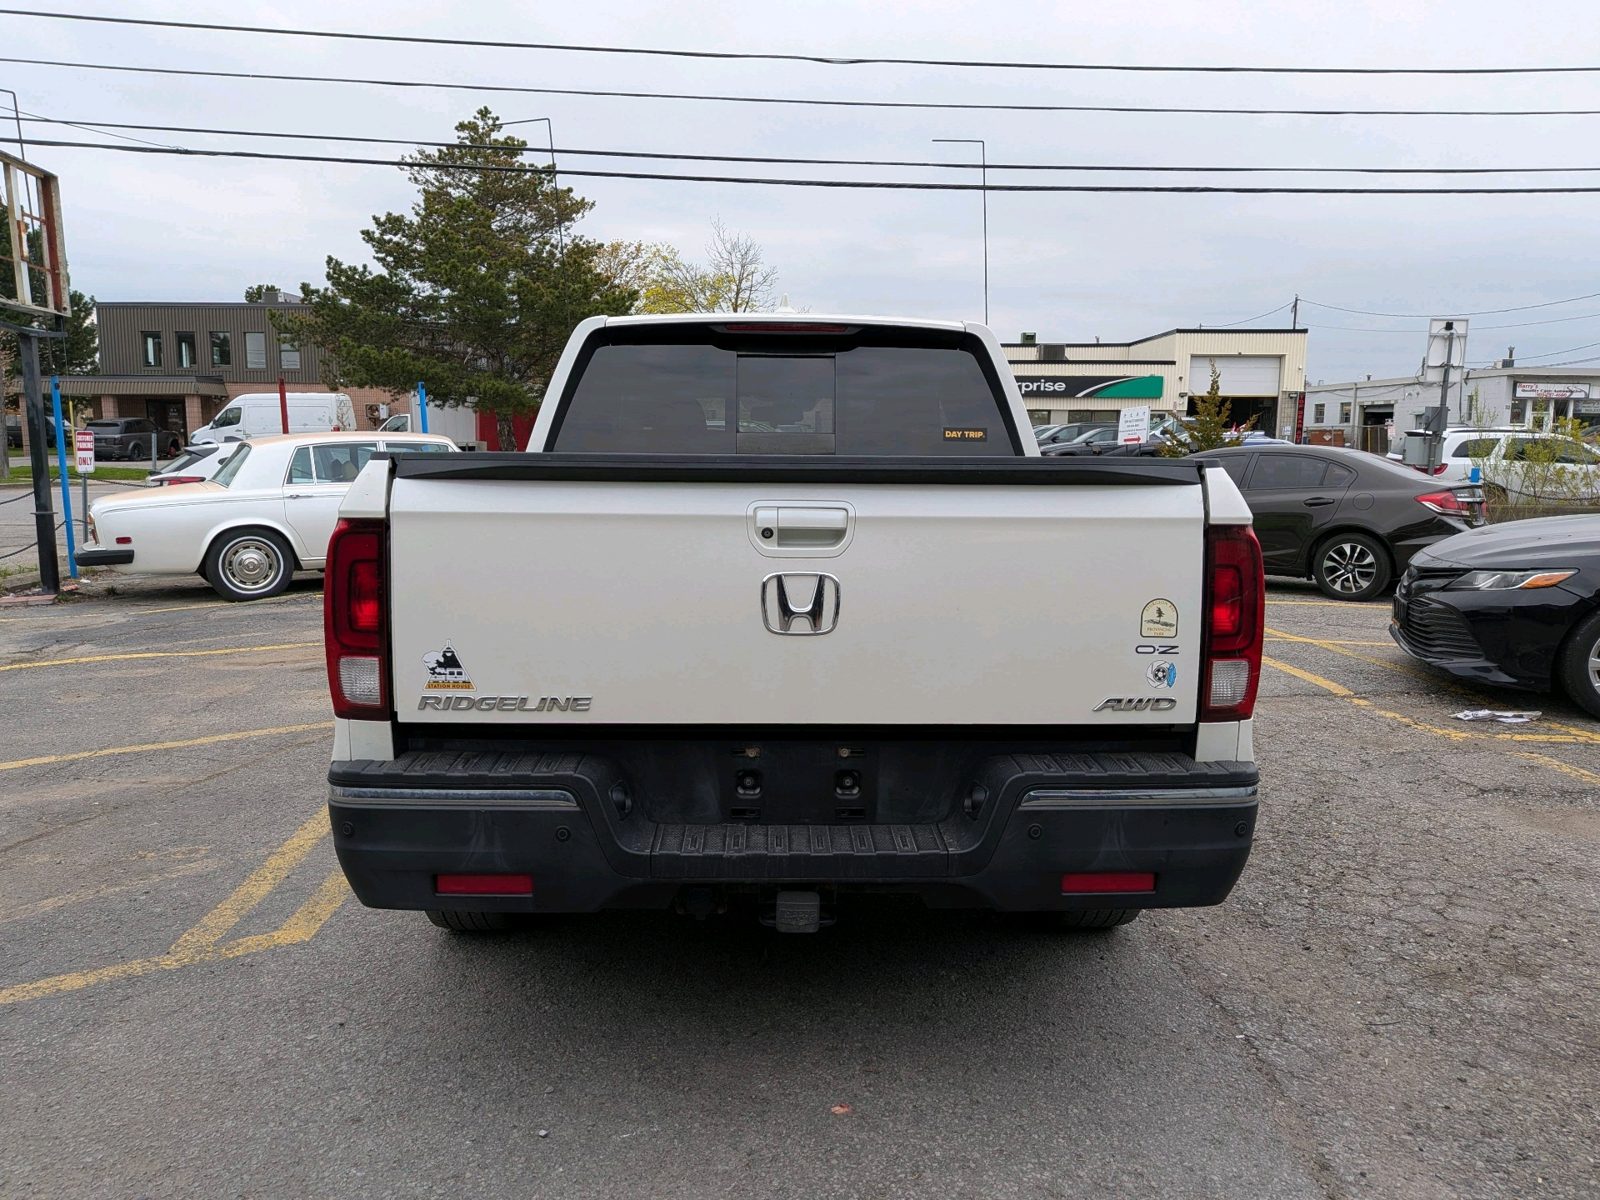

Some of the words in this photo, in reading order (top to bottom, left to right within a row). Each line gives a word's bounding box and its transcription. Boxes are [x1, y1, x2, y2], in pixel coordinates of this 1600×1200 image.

[78, 456, 93, 466] ONLY
[417, 695, 593, 711] RIDGELINE
[1092, 696, 1177, 711] AWD
